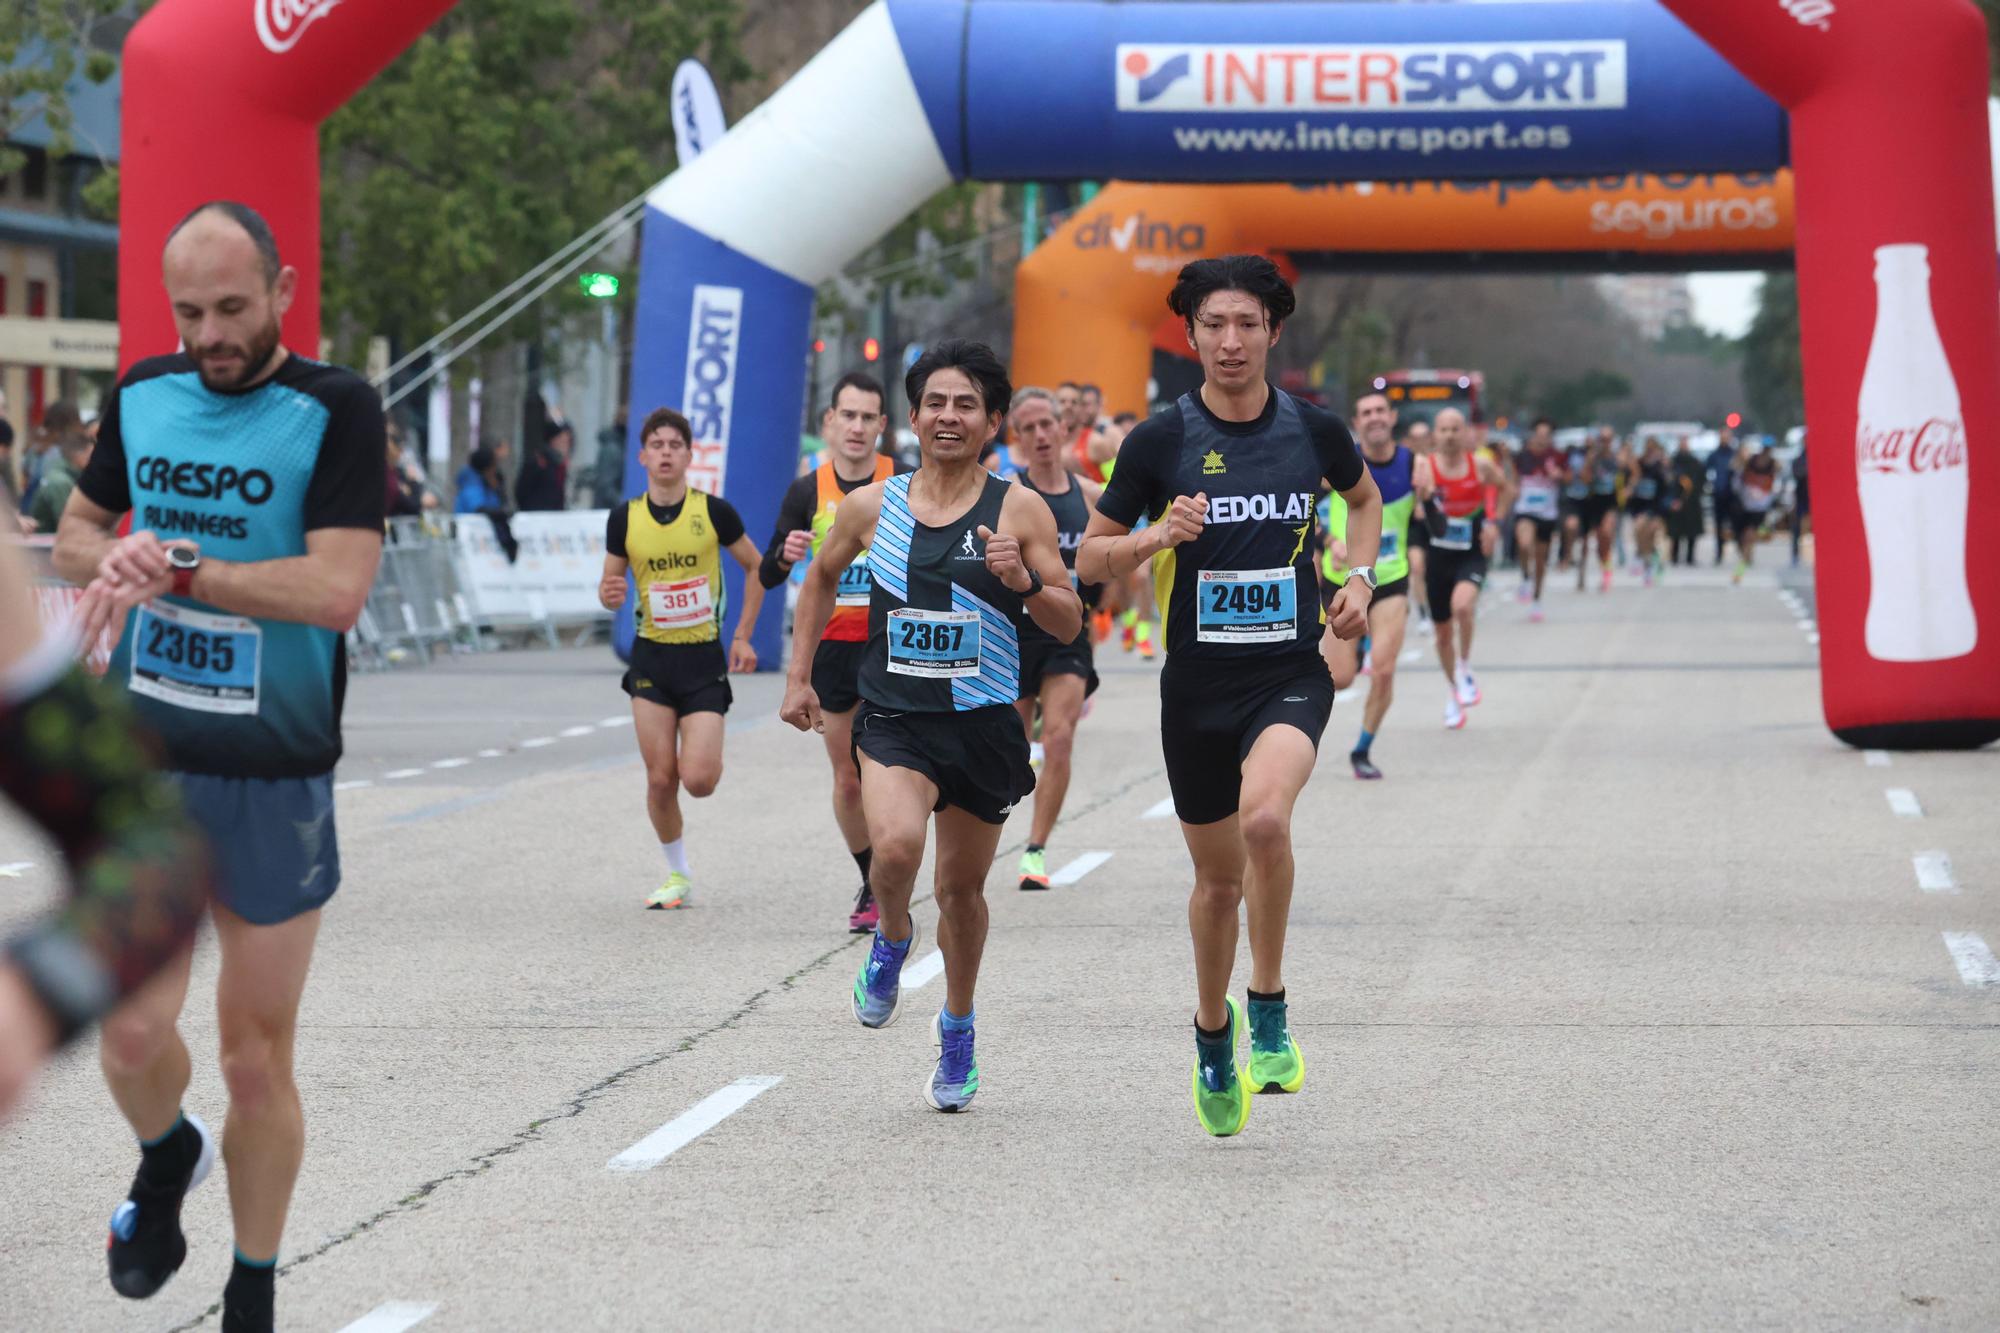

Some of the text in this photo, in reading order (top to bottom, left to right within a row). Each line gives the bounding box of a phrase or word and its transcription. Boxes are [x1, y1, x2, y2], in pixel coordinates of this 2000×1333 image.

[1204, 51, 1605, 104] INTERSPORT
[1174, 121, 1571, 155] www.intersport.es
[1590, 198, 1778, 238] seguros
[137, 456, 274, 505] CRESPO
[1202, 467, 1227, 475] luanvi
[144, 505, 248, 540] RUNNERS
[648, 552, 698, 572] teika
[838, 564, 872, 585] 272
[663, 591, 699, 610] 381
[1211, 583, 1282, 614] 2494
[147, 617, 235, 674] 2365
[901, 621, 964, 652] 2367
